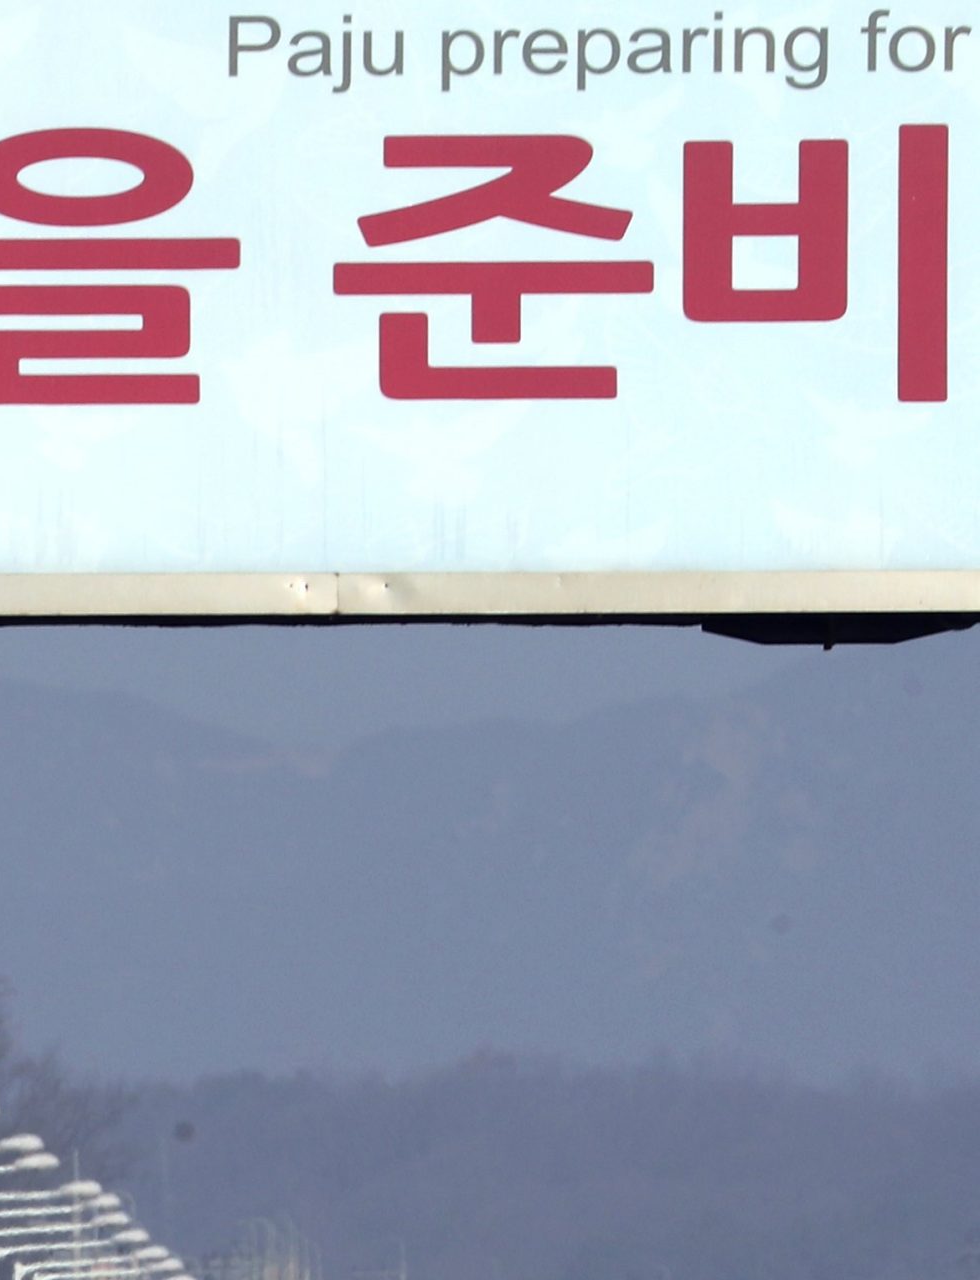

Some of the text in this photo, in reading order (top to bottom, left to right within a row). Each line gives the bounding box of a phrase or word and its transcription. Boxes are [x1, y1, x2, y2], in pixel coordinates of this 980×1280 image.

[228, 9, 973, 94] Paju preparing for
[333, 124, 950, 403] 준비
